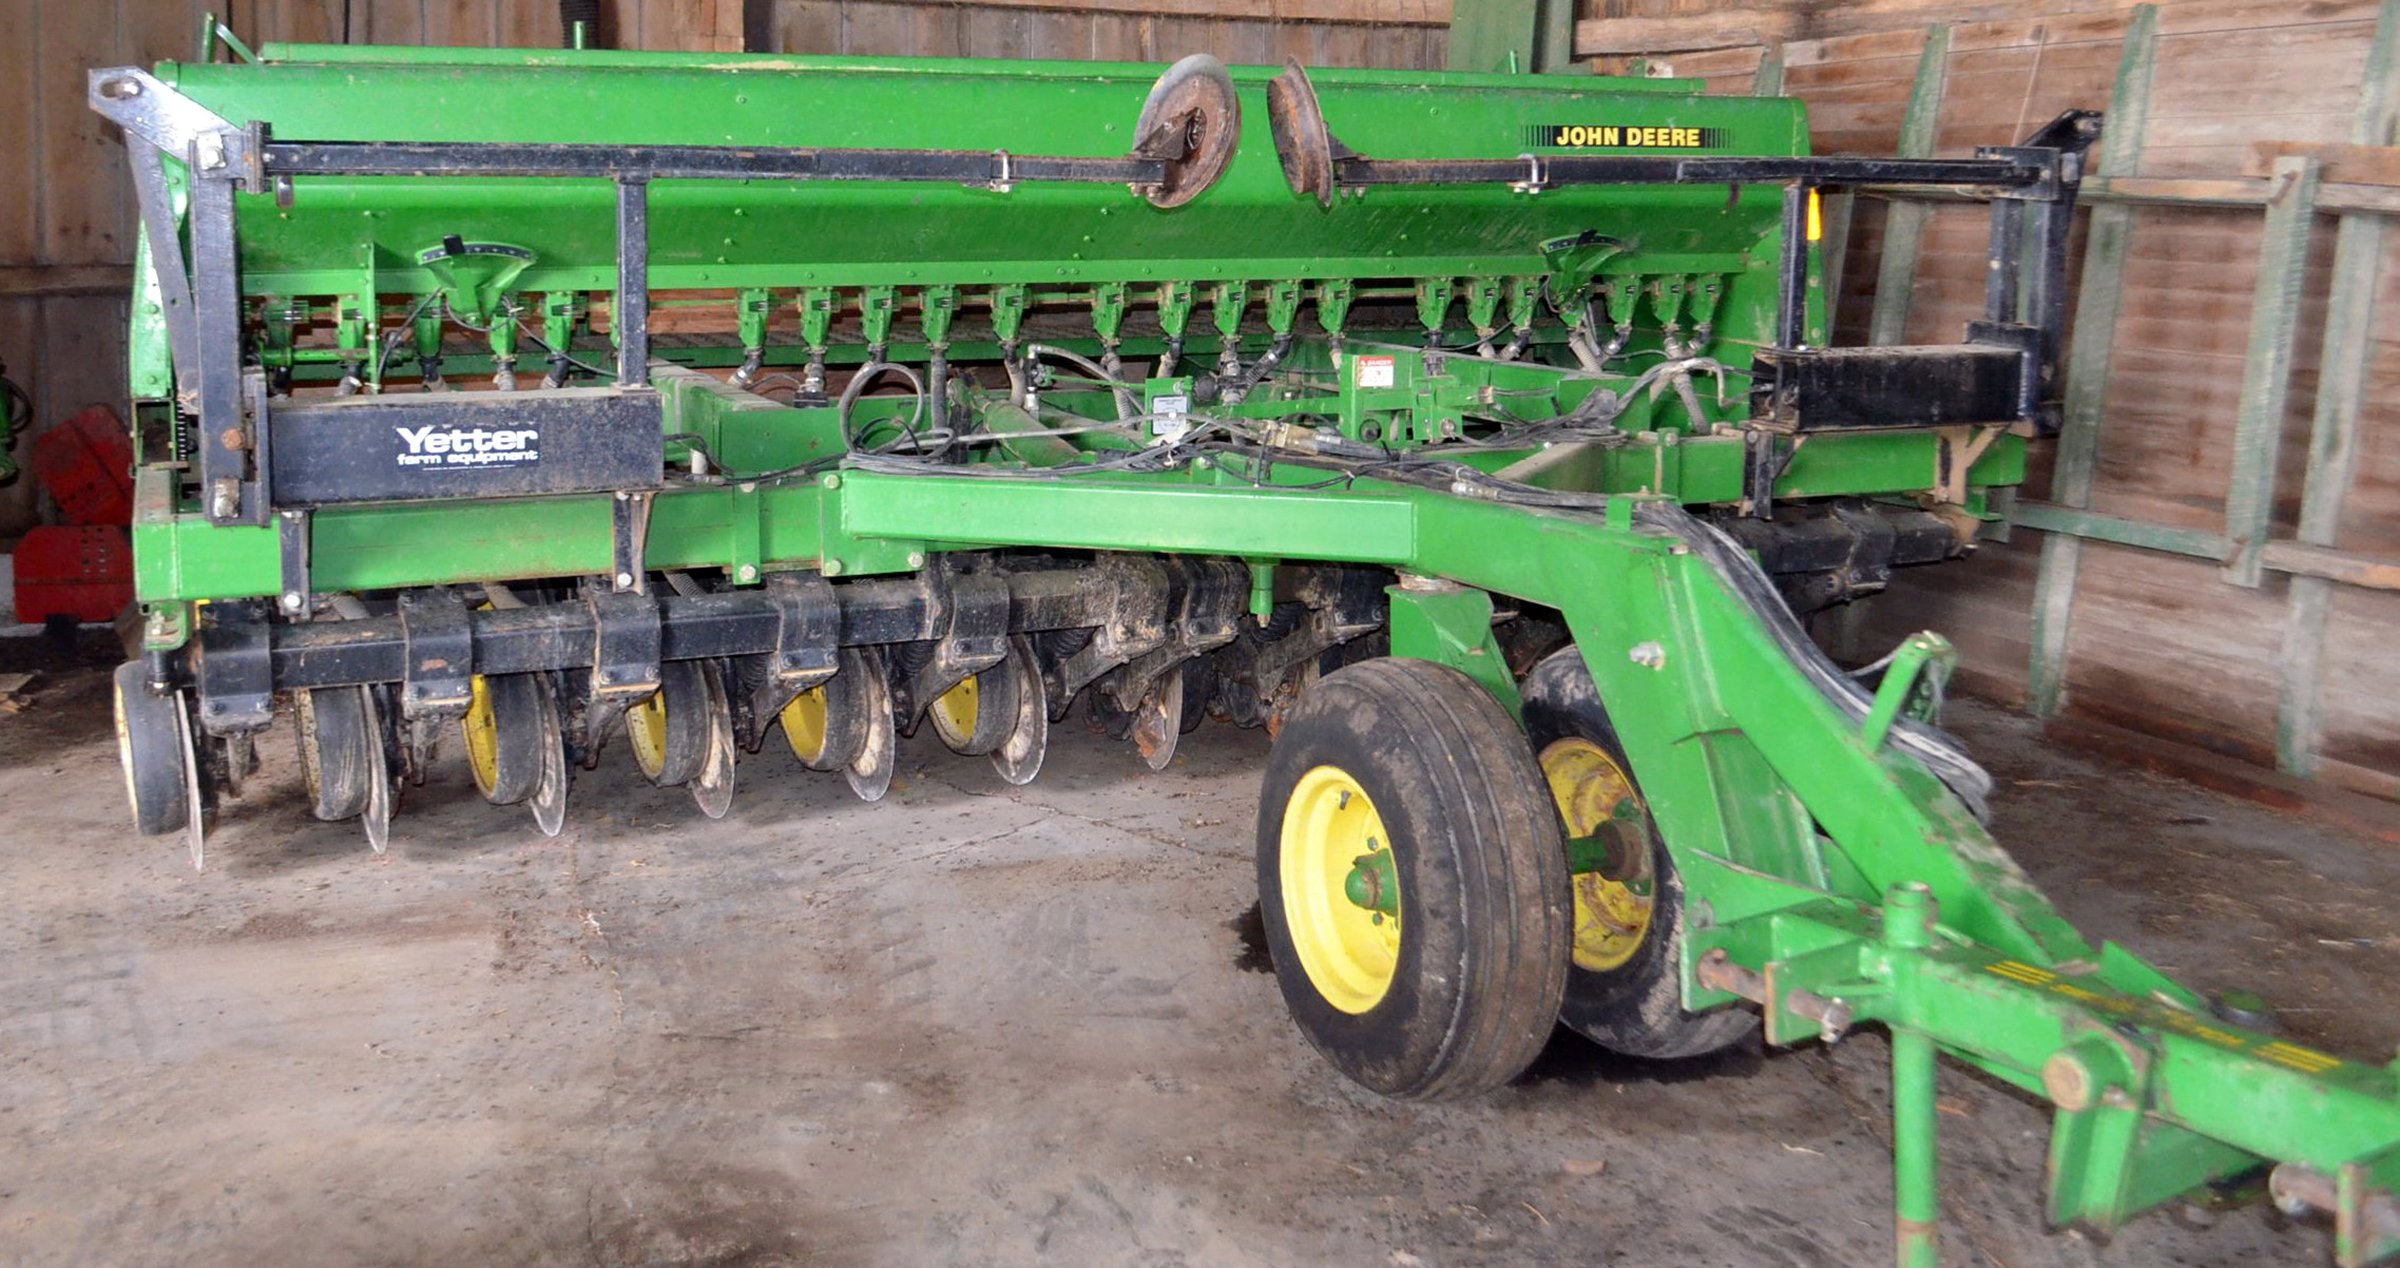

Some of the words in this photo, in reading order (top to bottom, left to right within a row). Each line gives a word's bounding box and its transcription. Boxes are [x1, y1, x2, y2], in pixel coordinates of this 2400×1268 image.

[1556, 126, 1620, 146] JOHN
[1626, 127, 1701, 147] DEERE
[396, 426, 538, 454] Yetter
[396, 453, 442, 465] farm
[446, 450, 539, 465] equipment
